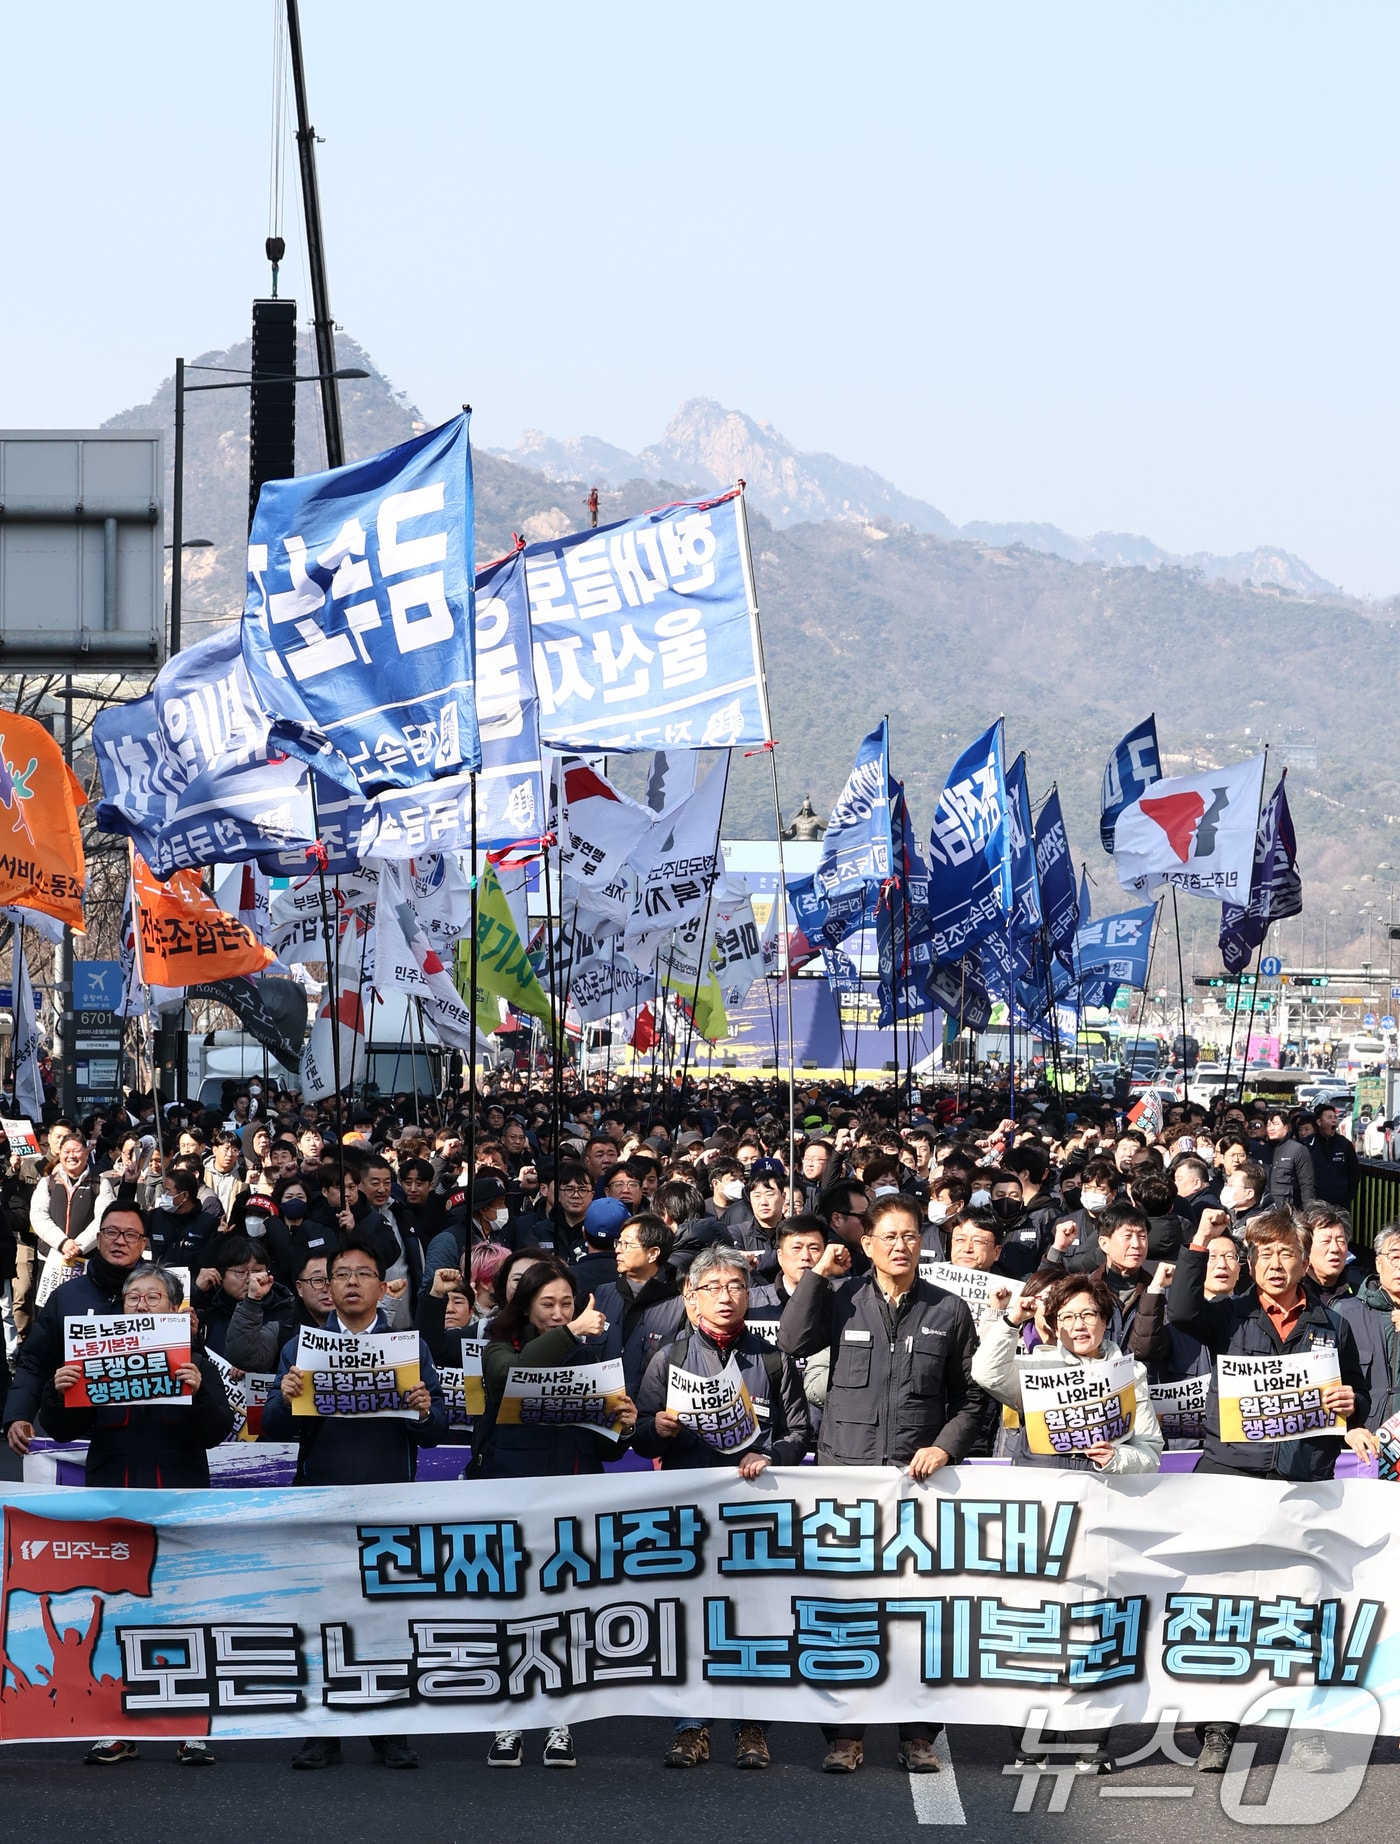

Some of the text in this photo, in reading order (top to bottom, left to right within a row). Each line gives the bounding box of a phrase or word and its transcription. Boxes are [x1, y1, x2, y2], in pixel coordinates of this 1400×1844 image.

[80, 1012, 112, 1025] 6701
[936, 1267, 989, 1287] 진짜사장
[960, 1286, 990, 1300] 나와
[69, 1317, 156, 1340] 모든 노동자의
[72, 1336, 140, 1358] 노동기본권
[301, 1330, 360, 1352] 진짜사장
[83, 1351, 170, 1380] 투쟁으로
[329, 1350, 385, 1369] 나와라!
[1222, 1360, 1283, 1376] 진짜사장
[313, 1371, 396, 1393] 원청교섭
[511, 1369, 575, 1385] 진짜사장
[541, 1380, 597, 1396] 나와라!
[671, 1371, 720, 1396] 진짜사장
[1025, 1370, 1085, 1390] 진짜사장
[1254, 1370, 1309, 1393] 나와라!
[86, 1376, 183, 1405] 쟁취하자!
[692, 1381, 737, 1411] 나와라!
[1057, 1378, 1110, 1405] 나와라!
[1150, 1381, 1203, 1401] 진짜사장
[314, 1390, 411, 1415] 쟁취하자!
[521, 1397, 606, 1412] 원청교섭
[677, 1394, 747, 1432] 원청교섭
[1044, 1396, 1121, 1431] 원청교섭
[1239, 1388, 1322, 1418] 원청교섭
[520, 1411, 617, 1429] 쟁취하자!
[1241, 1410, 1336, 1441] 쟁취하자!
[1049, 1413, 1132, 1452] 쟁취하자!
[53, 1540, 130, 1561] 민주노총
[358, 1497, 1079, 1599] 진짜 사장 교섭시대!
[116, 1591, 1384, 1713] 모든 노동자의 노동기본권 쟁취!
